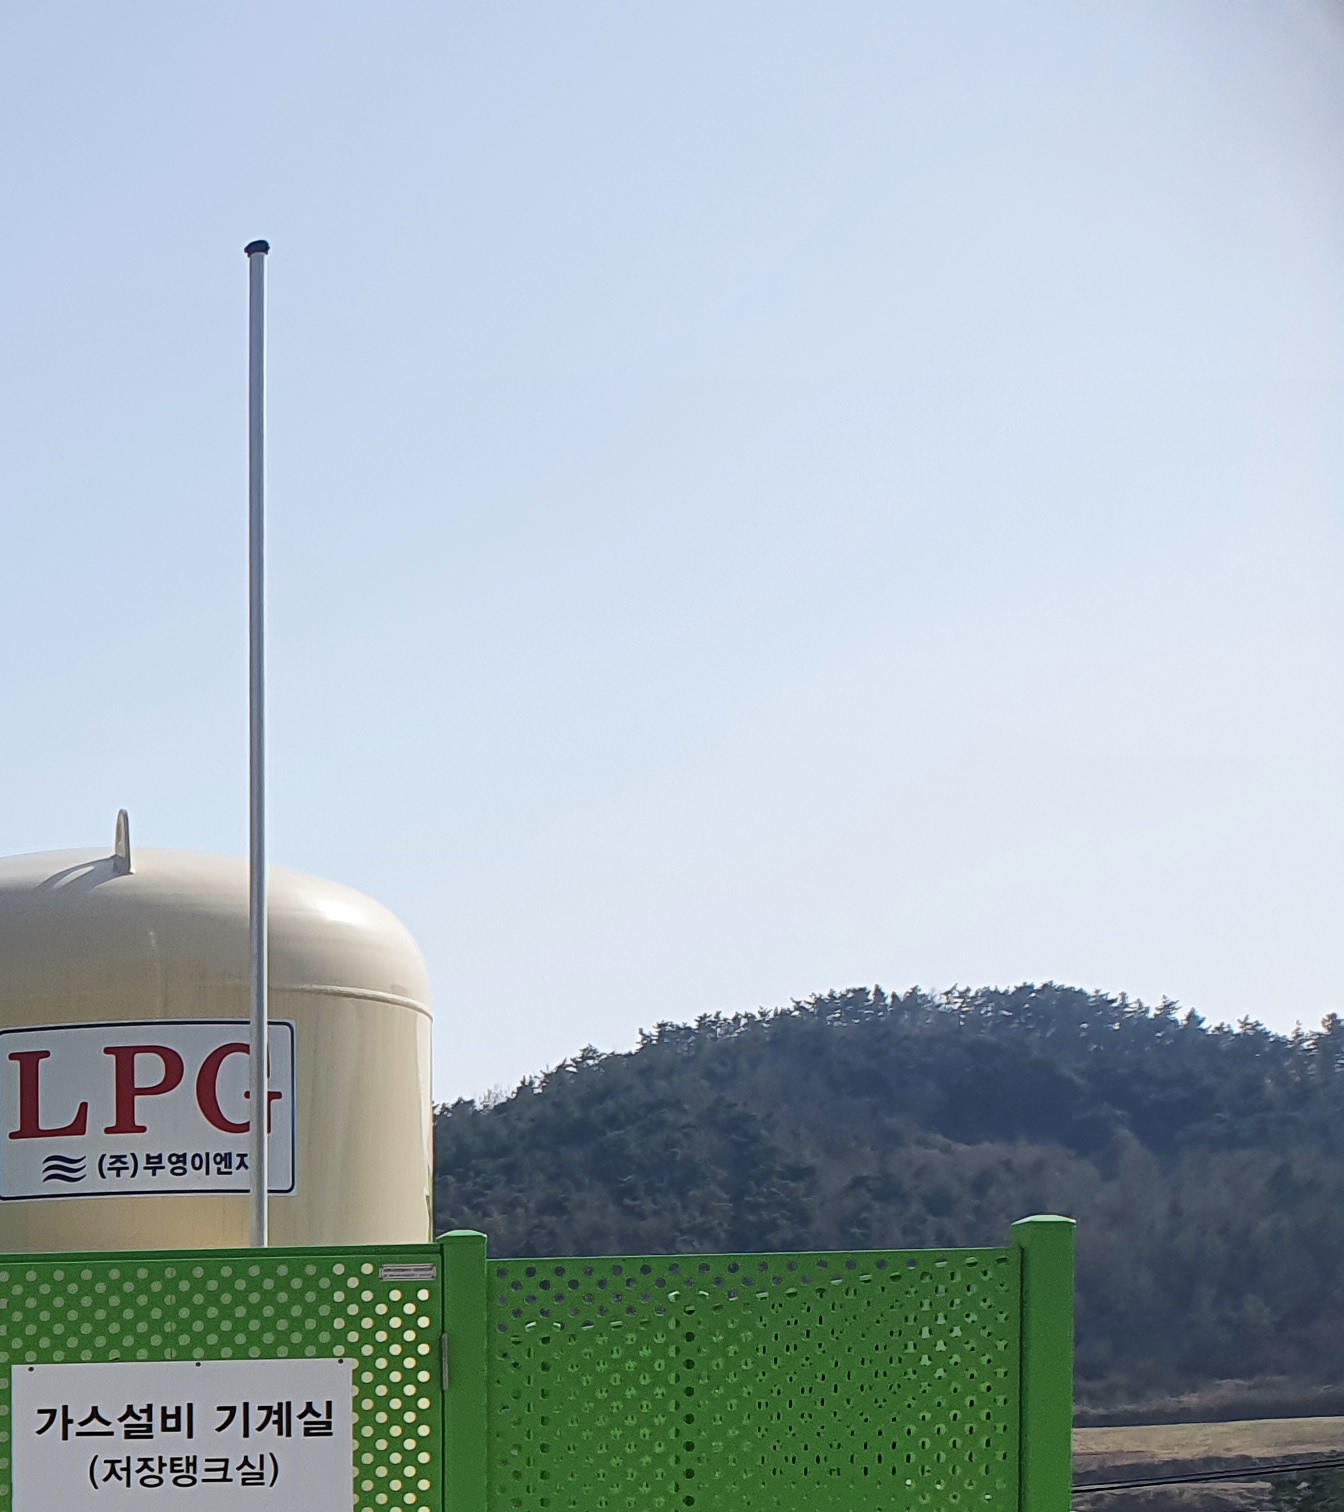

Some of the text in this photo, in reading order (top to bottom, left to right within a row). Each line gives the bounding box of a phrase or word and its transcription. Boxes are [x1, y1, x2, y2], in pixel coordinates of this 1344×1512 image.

[8, 1042, 283, 1140] LPG
[35, 1399, 334, 1441] 가스설비 기계실
[88, 1452, 279, 1489] (저장탱크실)
